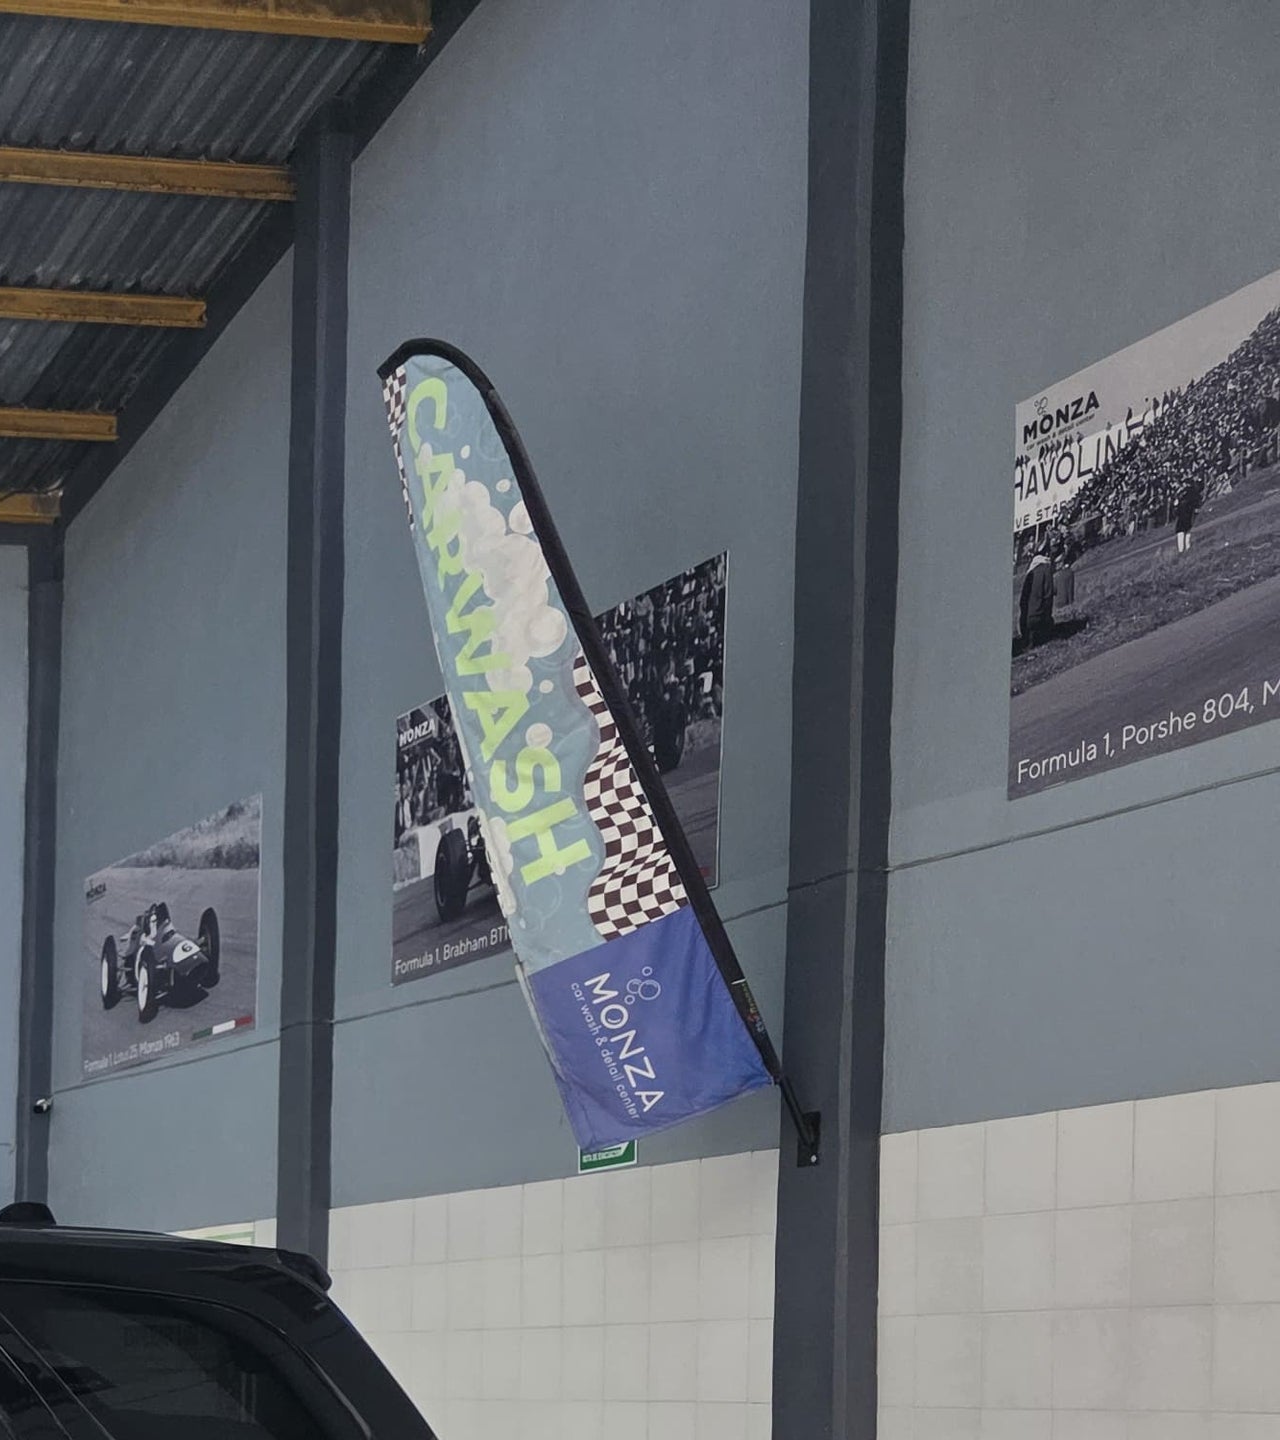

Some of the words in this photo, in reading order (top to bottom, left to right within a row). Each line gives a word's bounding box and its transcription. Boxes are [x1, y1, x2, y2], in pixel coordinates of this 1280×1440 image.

[1023, 391, 1100, 444] MONZA
[406, 376, 593, 886] CARWASH
[399, 719, 436, 747] MONZA
[1017, 740, 1097, 784] Formula
[1103, 733, 1115, 758] 1,
[1122, 711, 1196, 750] Porshe
[1202, 687, 1255, 724] 804,
[181, 943, 192, 953] 6
[395, 952, 433, 976] Formula
[443, 935, 489, 961] Brabham
[571, 982, 585, 1002] car
[580, 1003, 602, 1036] wash
[584, 972, 665, 1112] MONZA
[595, 1036, 608, 1047] &
[601, 1046, 624, 1082] detail
[616, 1083, 640, 1120] center
